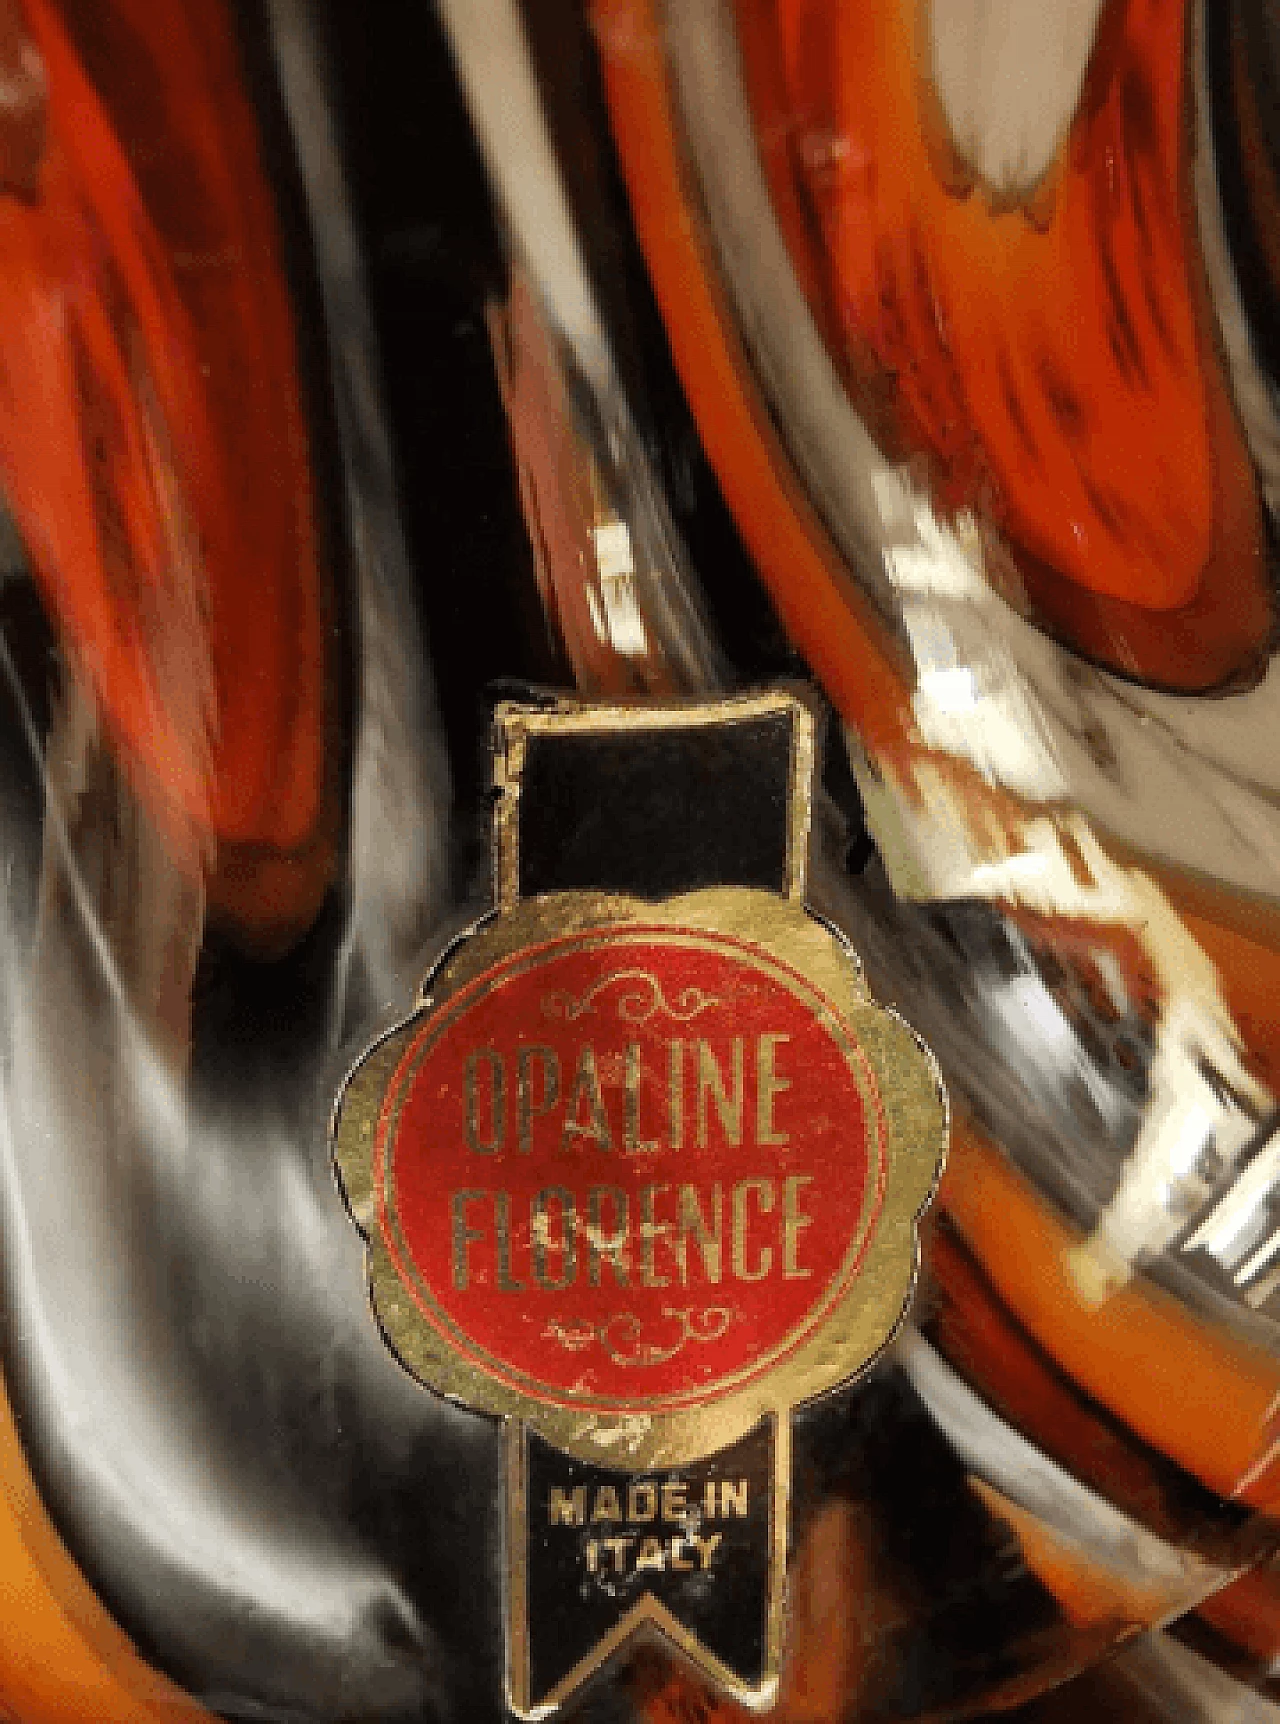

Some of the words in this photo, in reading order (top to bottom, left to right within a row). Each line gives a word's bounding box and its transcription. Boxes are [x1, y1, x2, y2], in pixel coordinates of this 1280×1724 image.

[463, 1032, 792, 1155] OPALINE
[450, 1174, 814, 1292] FLORENCE
[548, 1482, 691, 1526] MADE
[704, 1479, 748, 1519] IN
[586, 1532, 723, 1573] ITALY
